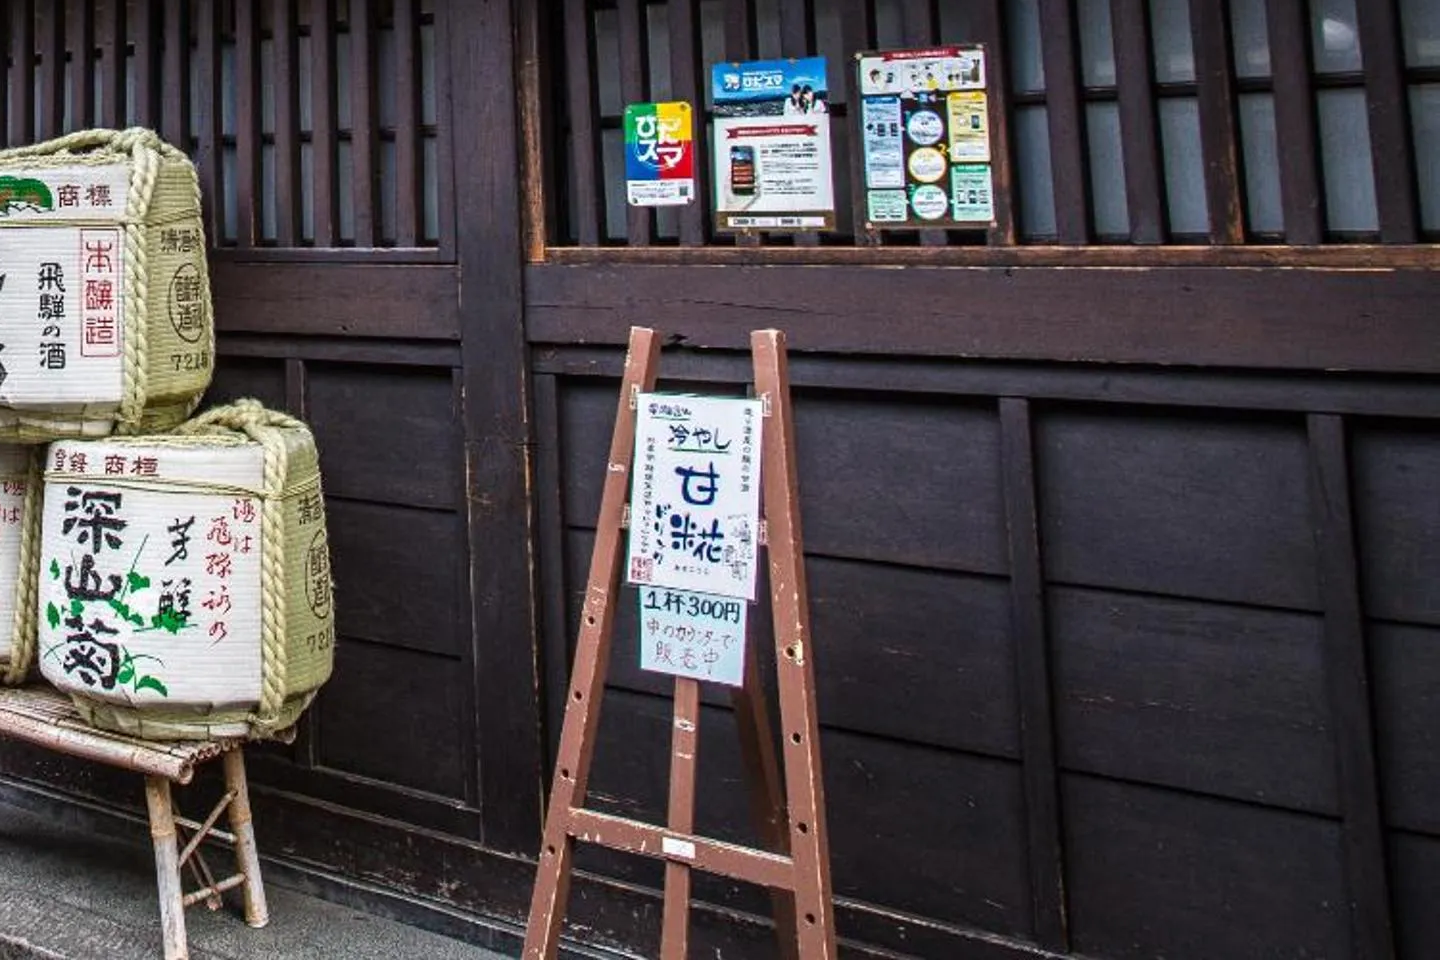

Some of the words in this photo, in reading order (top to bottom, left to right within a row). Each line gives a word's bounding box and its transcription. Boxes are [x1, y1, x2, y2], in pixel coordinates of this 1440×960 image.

[57, 184, 113, 208] 商標
[85, 239, 115, 346] 本醸造
[37, 262, 66, 370] 飛騨の酒
[667, 423, 732, 450] 冷やし
[62, 486, 128, 691] 深山菊
[643, 591, 741, 625] 1杯300円
[654, 641, 721, 676] 販売中
